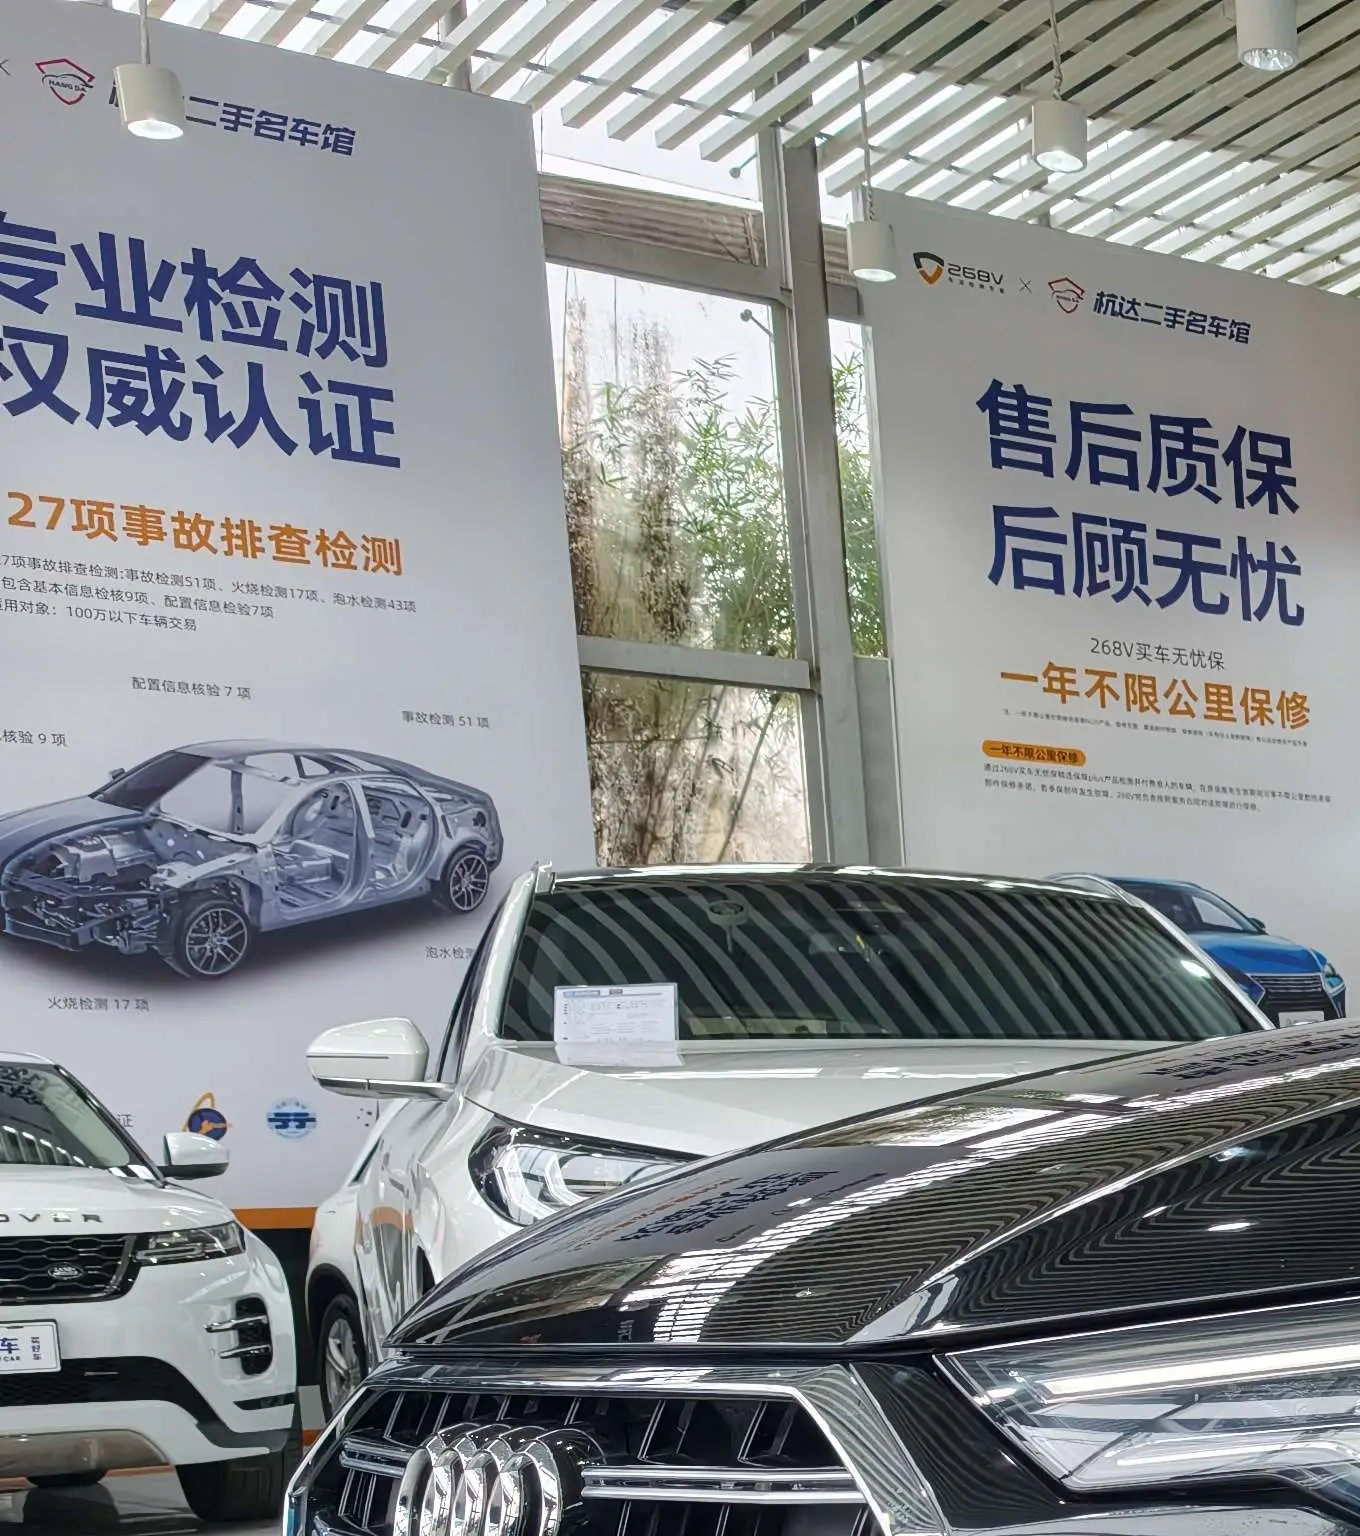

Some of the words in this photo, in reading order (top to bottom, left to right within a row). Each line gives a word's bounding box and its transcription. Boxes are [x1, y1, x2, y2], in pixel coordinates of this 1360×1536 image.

[108, 80, 356, 156] 二手名车馆
[0, 211, 388, 367] 专业检测
[948, 263, 1003, 285] 268V
[1093, 290, 1251, 345] 杭达二手名车馆
[975, 378, 1300, 515] 售后质保
[7, 491, 403, 577] 27项事故排查检测
[0, 554, 417, 613] 7项事故排查检测:事故检测51项、火烧检测17项、泡水检测43项
[988, 505, 1305, 627] 后顾无忧
[0, 598, 197, 632] 用对象：100万以下车辆交易
[1089, 637, 1226, 671] 268V买车无忧保
[131, 676, 221, 698] 配置信息核验
[226, 686, 233, 697] 7
[237, 686, 252, 700] 项
[1000, 661, 1311, 731] 一年不限公里保修
[0, 728, 33, 745] 核验
[38, 732, 47, 745] 9
[52, 733, 67, 747] 项
[401, 709, 455, 728] 事故检测
[458, 715, 473, 728] 51
[48, 995, 108, 1013] 火烧检测
[113, 998, 131, 1011] 17
